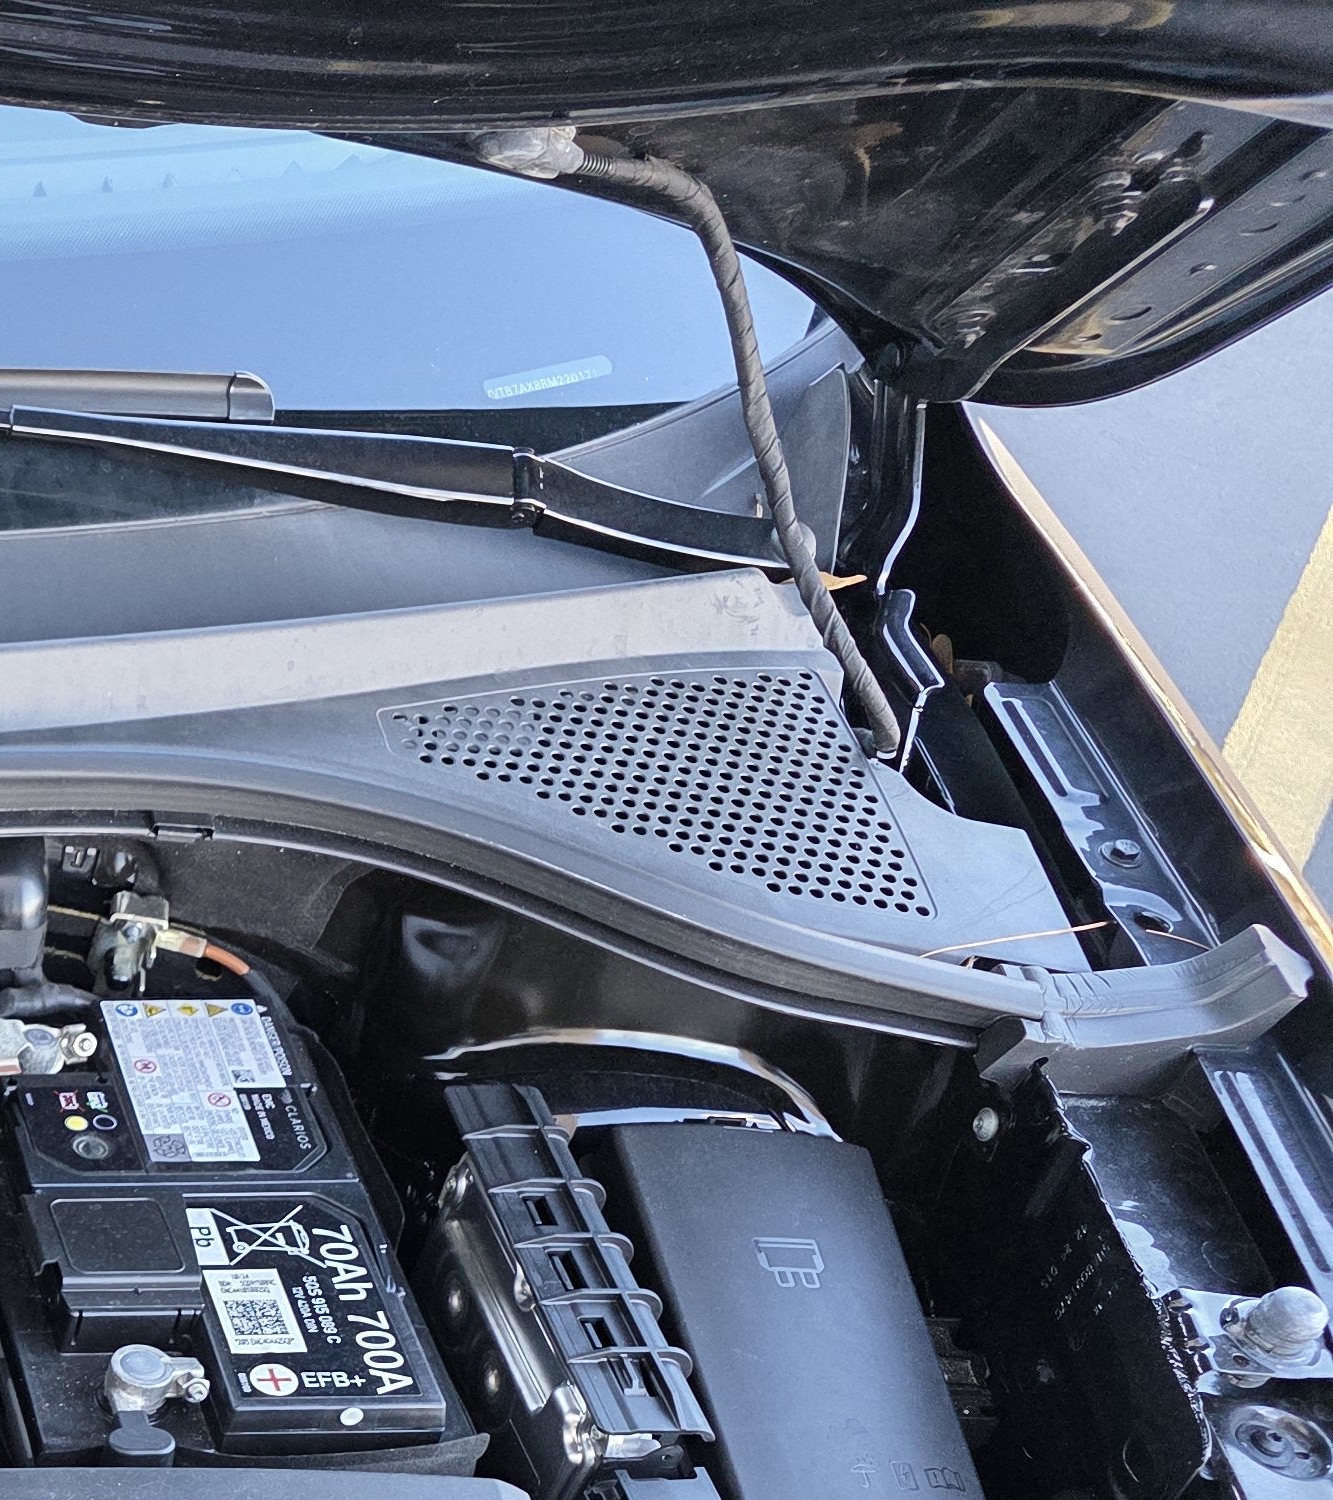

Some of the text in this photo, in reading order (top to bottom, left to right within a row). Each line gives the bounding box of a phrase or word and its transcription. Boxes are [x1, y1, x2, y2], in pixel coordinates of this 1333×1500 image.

[285, 1105, 312, 1150] CLARIOS
[190, 1226, 211, 1248] Pb
[312, 1225, 414, 1395] 70Ah 700A
[312, 1296, 330, 1315] 915
[327, 1335, 342, 1345] C
[300, 1371, 367, 1389] EFB+
